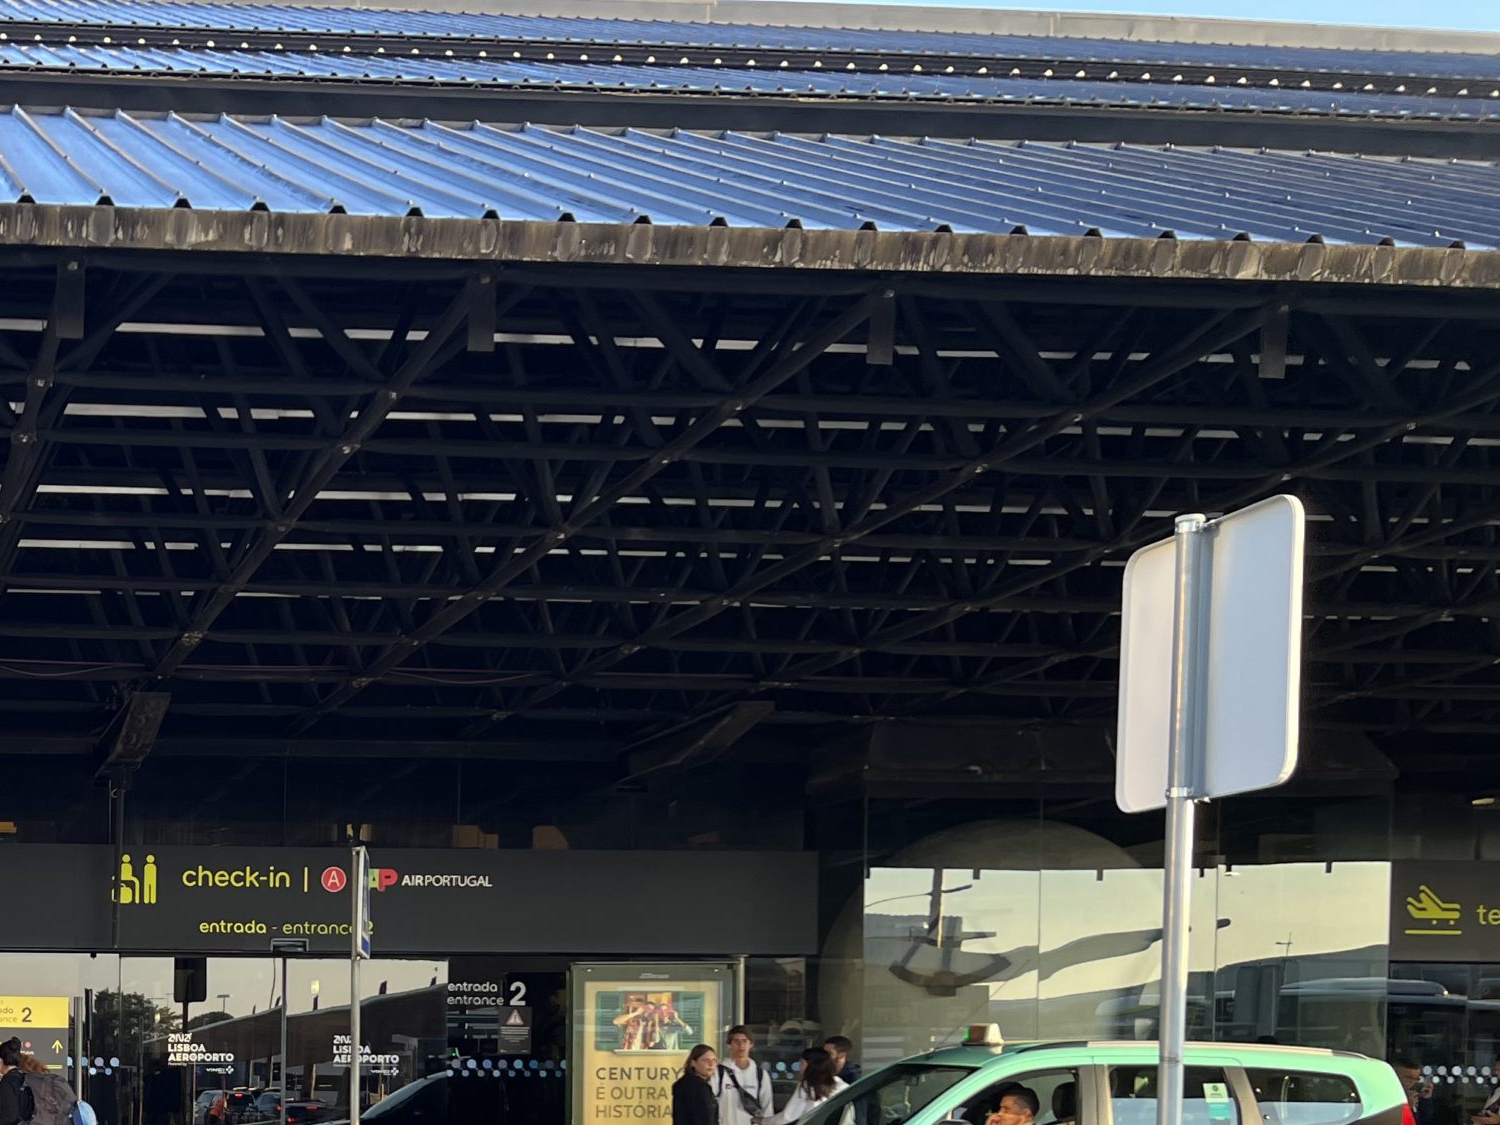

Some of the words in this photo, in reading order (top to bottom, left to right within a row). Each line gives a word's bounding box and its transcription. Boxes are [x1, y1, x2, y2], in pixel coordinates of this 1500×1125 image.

[182, 865, 291, 889] check-in
[369, 867, 399, 893] AP
[199, 919, 267, 935] entrada
[446, 995, 505, 1006] entrance
[447, 981, 498, 992] entrada
[509, 981, 527, 1006] 2
[21, 1006, 33, 1023] 2
[167, 1052, 235, 1062] AEROPORTO
[595, 1066, 683, 1081] CENTURY
[610, 1086, 669, 1100] OUTRA
[595, 1100, 672, 1118] HISTÓRIA
